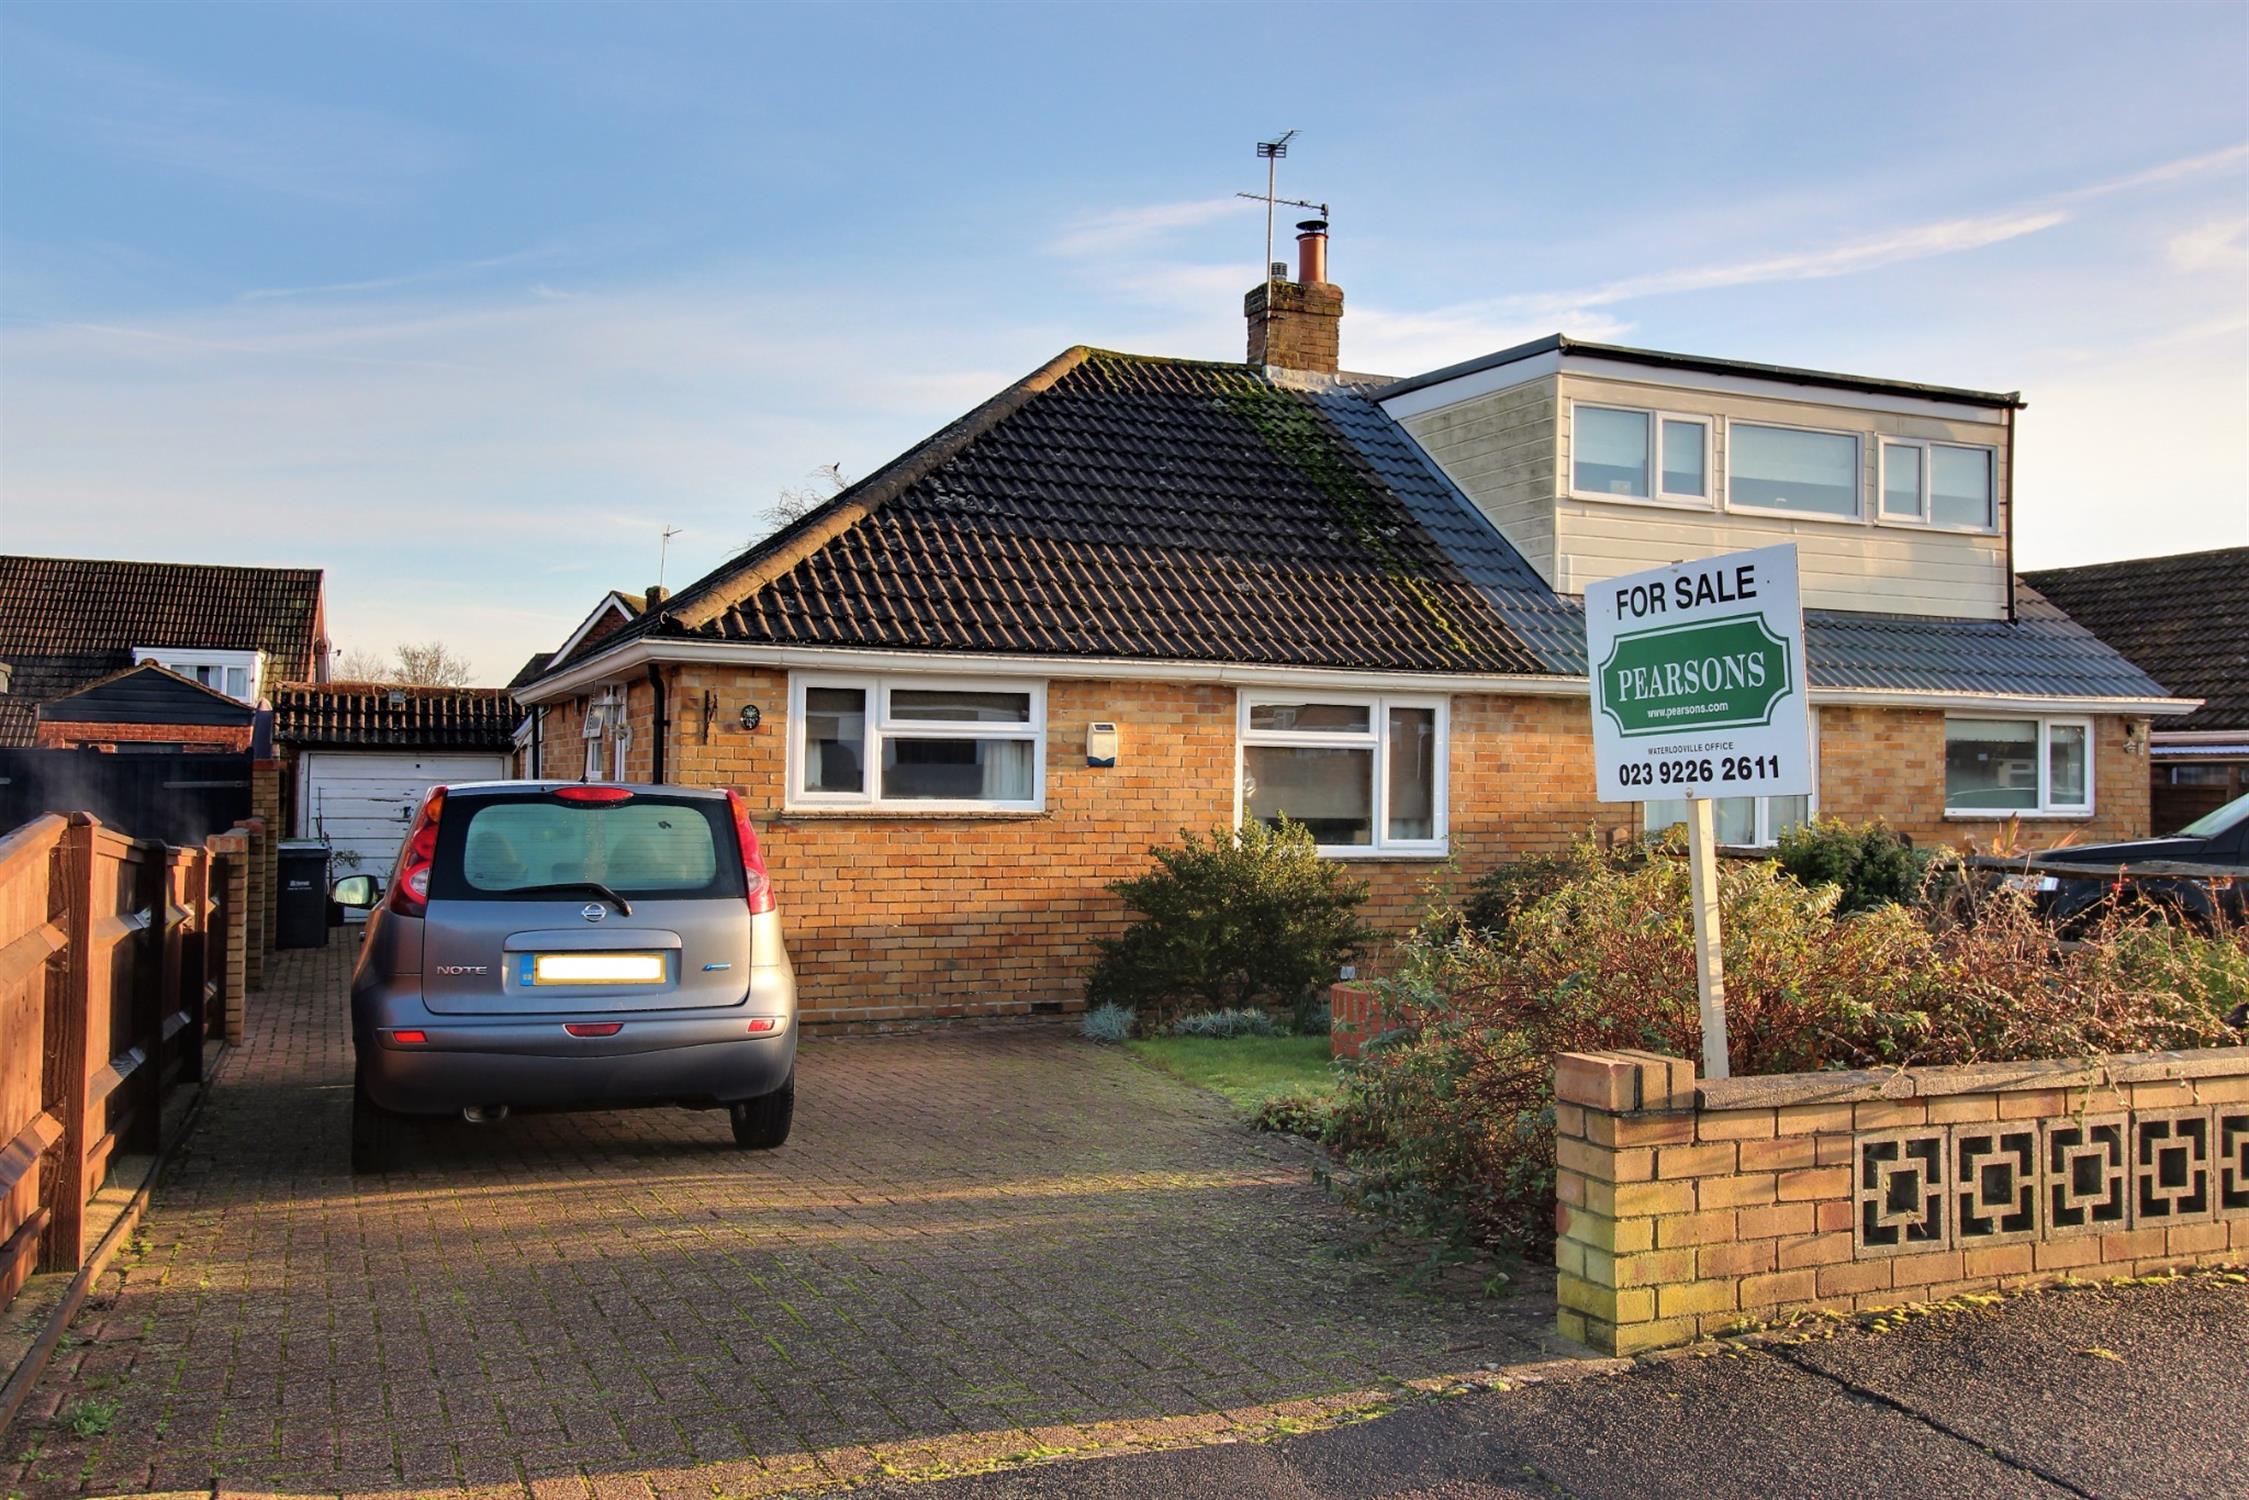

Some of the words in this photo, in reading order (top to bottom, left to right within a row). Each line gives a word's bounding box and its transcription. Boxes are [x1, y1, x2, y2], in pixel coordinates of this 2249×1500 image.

[1616, 582, 1666, 620] FOR
[1675, 565, 1757, 609] SALE
[1617, 651, 1766, 702] PEARSONS
[1647, 702, 1729, 719] www.pearsons.com
[1648, 744, 1703, 755] WATERLOOVILLE
[1704, 741, 1734, 751] OFFICE
[1619, 763, 1653, 786] 023
[1659, 759, 1713, 784] 9226
[1721, 755, 1779, 781] 2611
[437, 966, 487, 975] NOTE
